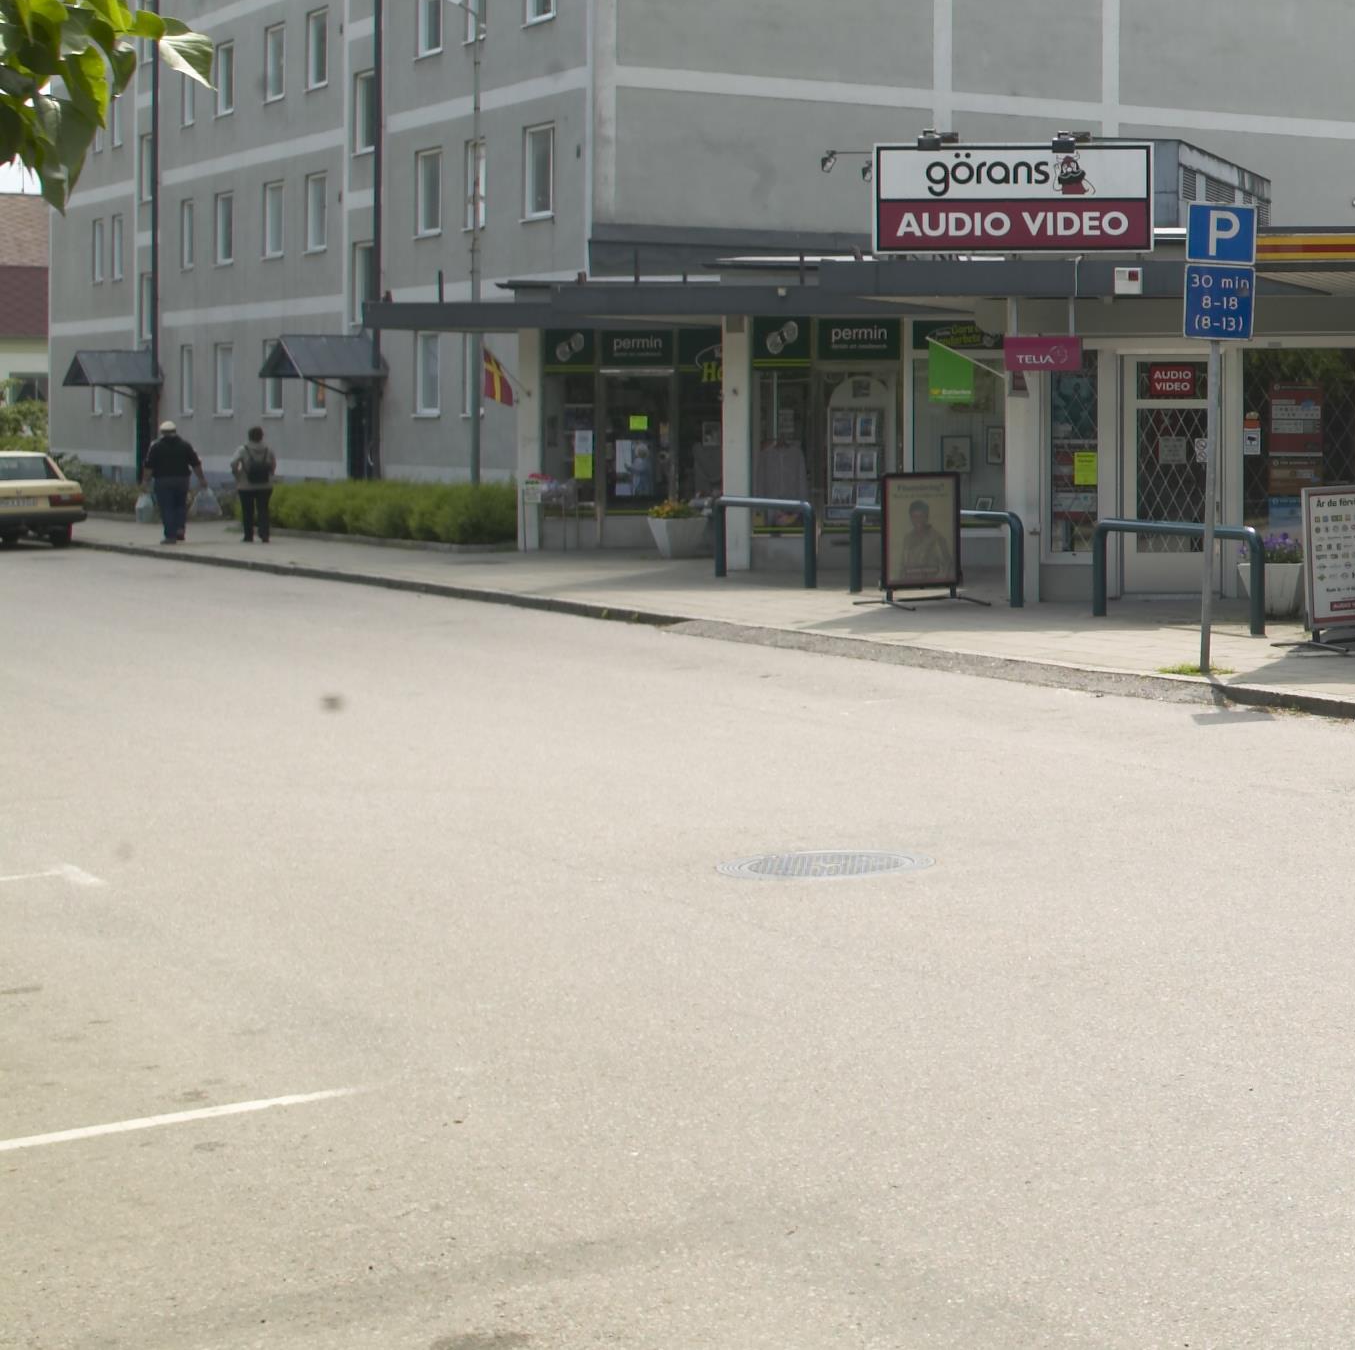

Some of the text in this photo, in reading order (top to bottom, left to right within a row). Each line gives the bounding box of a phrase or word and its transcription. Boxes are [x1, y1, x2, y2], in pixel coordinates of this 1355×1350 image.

[925, 151, 1051, 197] görans
[896, 210, 1129, 237] AUDIO VIDEO
[1208, 209, 1241, 257] P
[1191, 274, 1250, 289] 30 min
[1202, 295, 1239, 310] 8-18
[1194, 314, 1244, 331] (8-13)
[832, 324, 888, 342] permin
[613, 333, 663, 351] permin
[1016, 354, 1056, 364] TELIA
[1153, 369, 1192, 380] AUDIO
[1154, 381, 1191, 392] VIDEO
